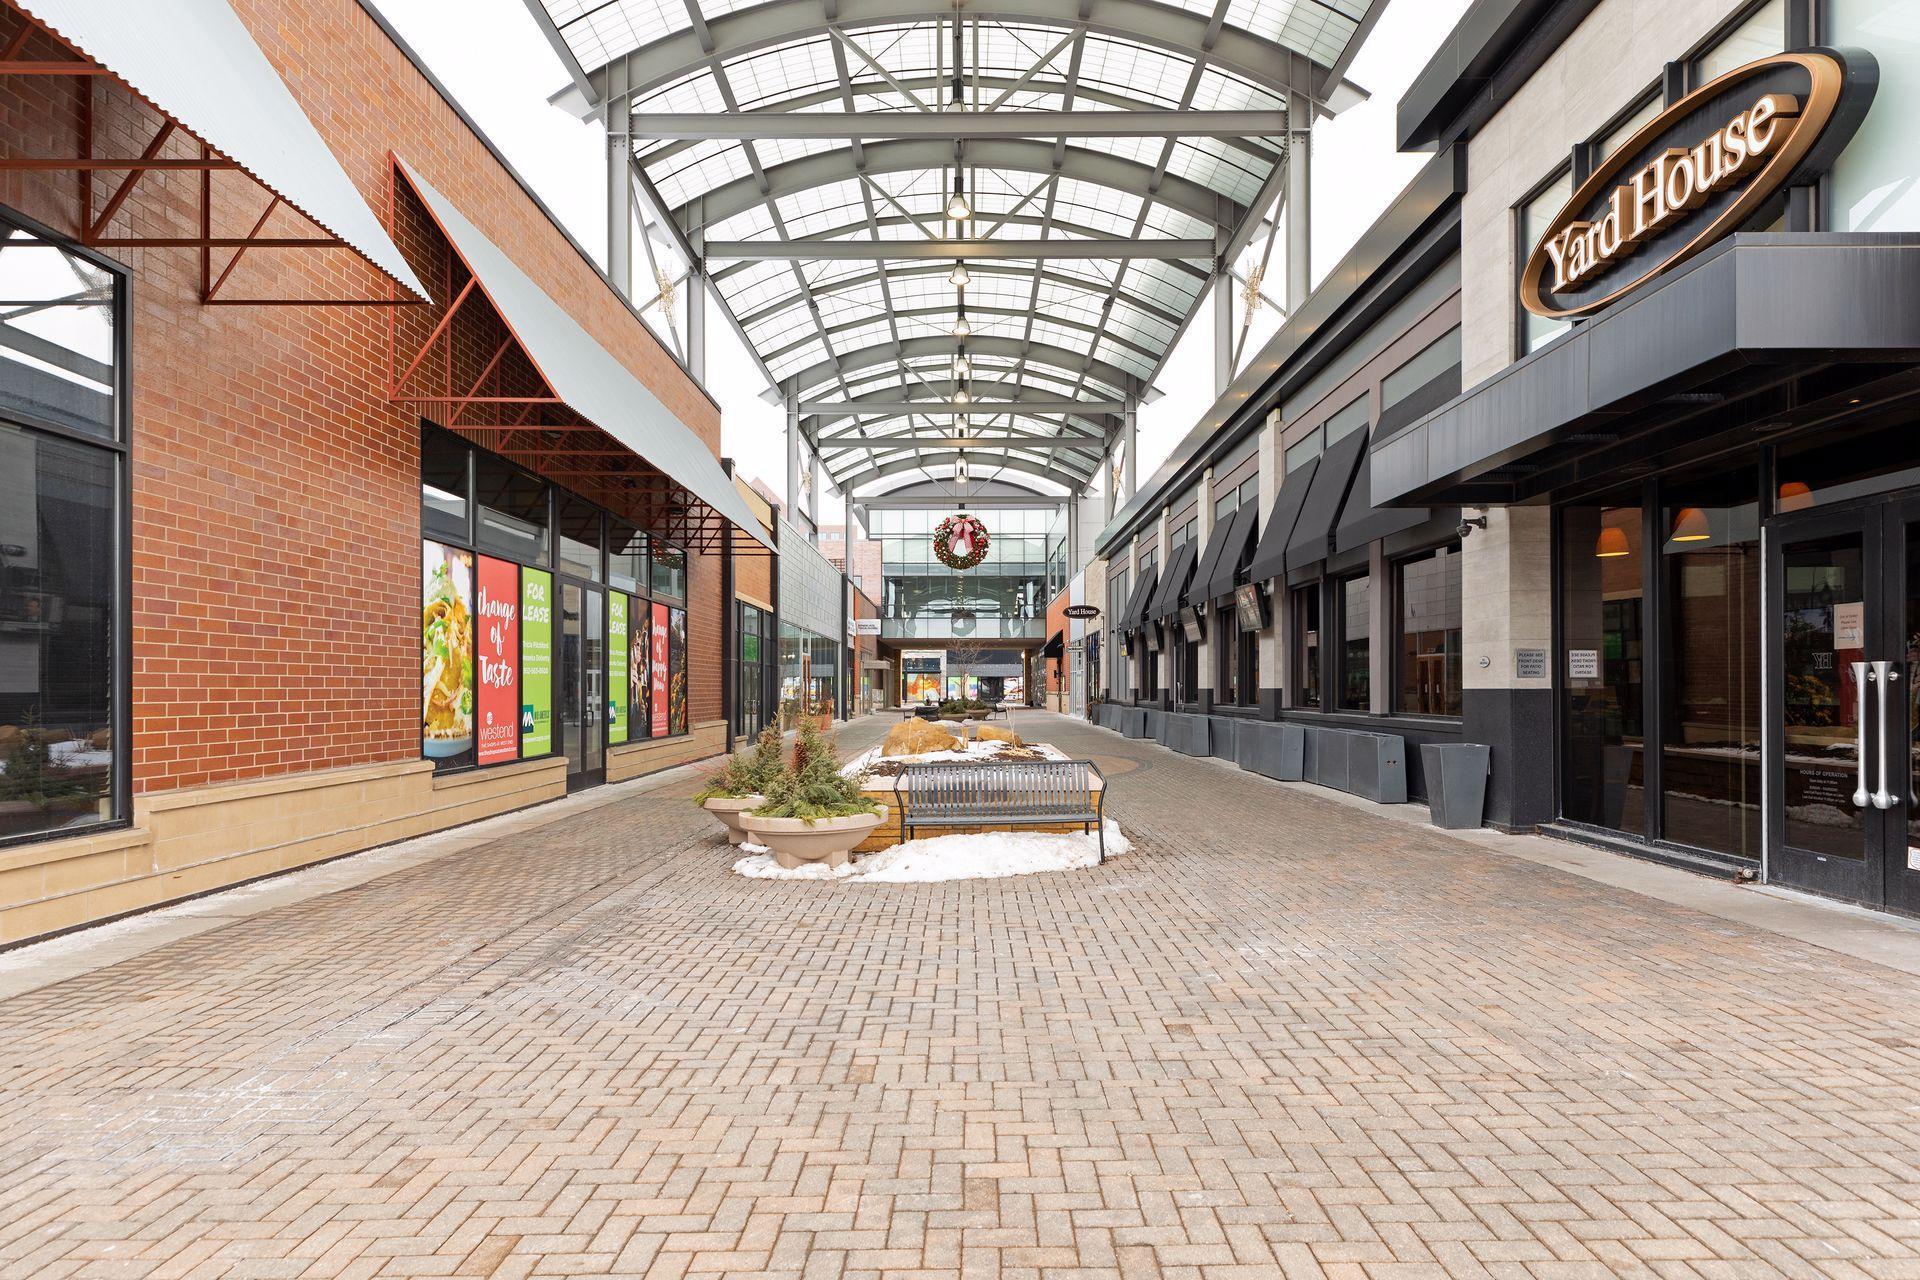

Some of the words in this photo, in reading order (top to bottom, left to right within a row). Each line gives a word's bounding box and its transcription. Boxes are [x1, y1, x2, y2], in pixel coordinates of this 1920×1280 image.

[1544, 188, 1625, 294] Yard
[1629, 94, 1781, 242] House
[526, 582, 544, 602] FOR
[478, 585, 515, 630] Change
[522, 604, 549, 624] LEASE
[611, 602, 624, 618] FOR
[490, 621, 504, 656] of
[652, 616, 668, 644] hange
[478, 655, 514, 688] Taste
[480, 721, 513, 740] westend
